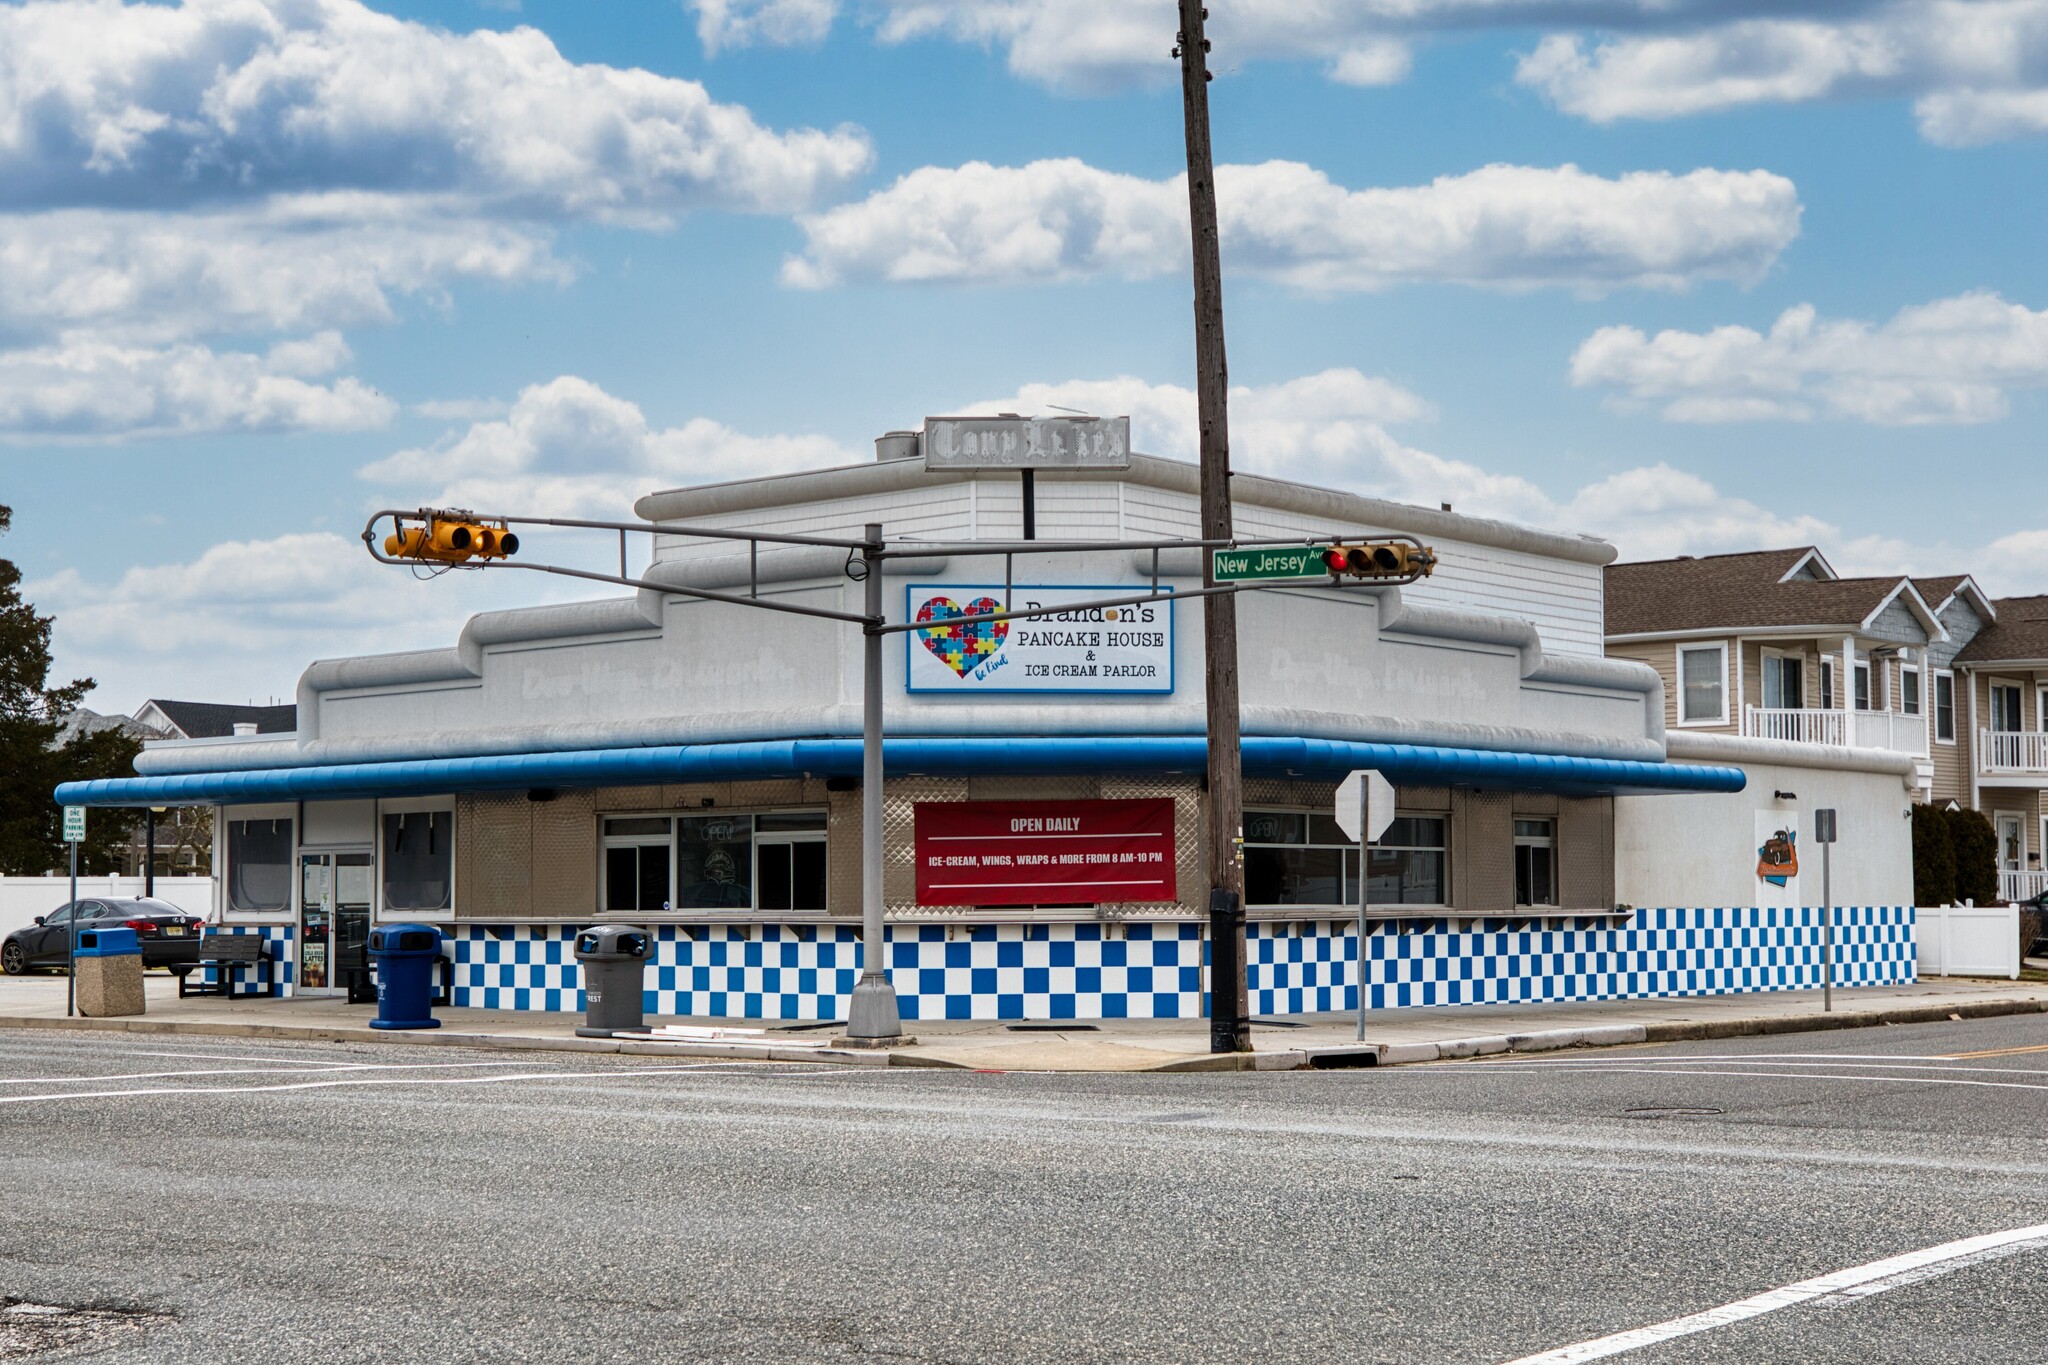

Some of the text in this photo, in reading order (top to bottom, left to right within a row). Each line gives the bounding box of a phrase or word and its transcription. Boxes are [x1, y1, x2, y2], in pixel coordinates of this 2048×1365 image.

[1217, 556, 1248, 574] New
[1255, 554, 1307, 574] Jersey
[1017, 632, 1164, 647] PANCAKE HOUSE
[1085, 650, 1096, 661] &
[1025, 665, 1156, 676] ICE CREAM PARLOR
[1010, 817, 1080, 832] OPEN DAILY
[701, 825, 732, 841] OPEN
[928, 852, 1162, 868] ICE-CREAM, WINGS, WRAPS & MORE FROM 8 AM-10 PM
